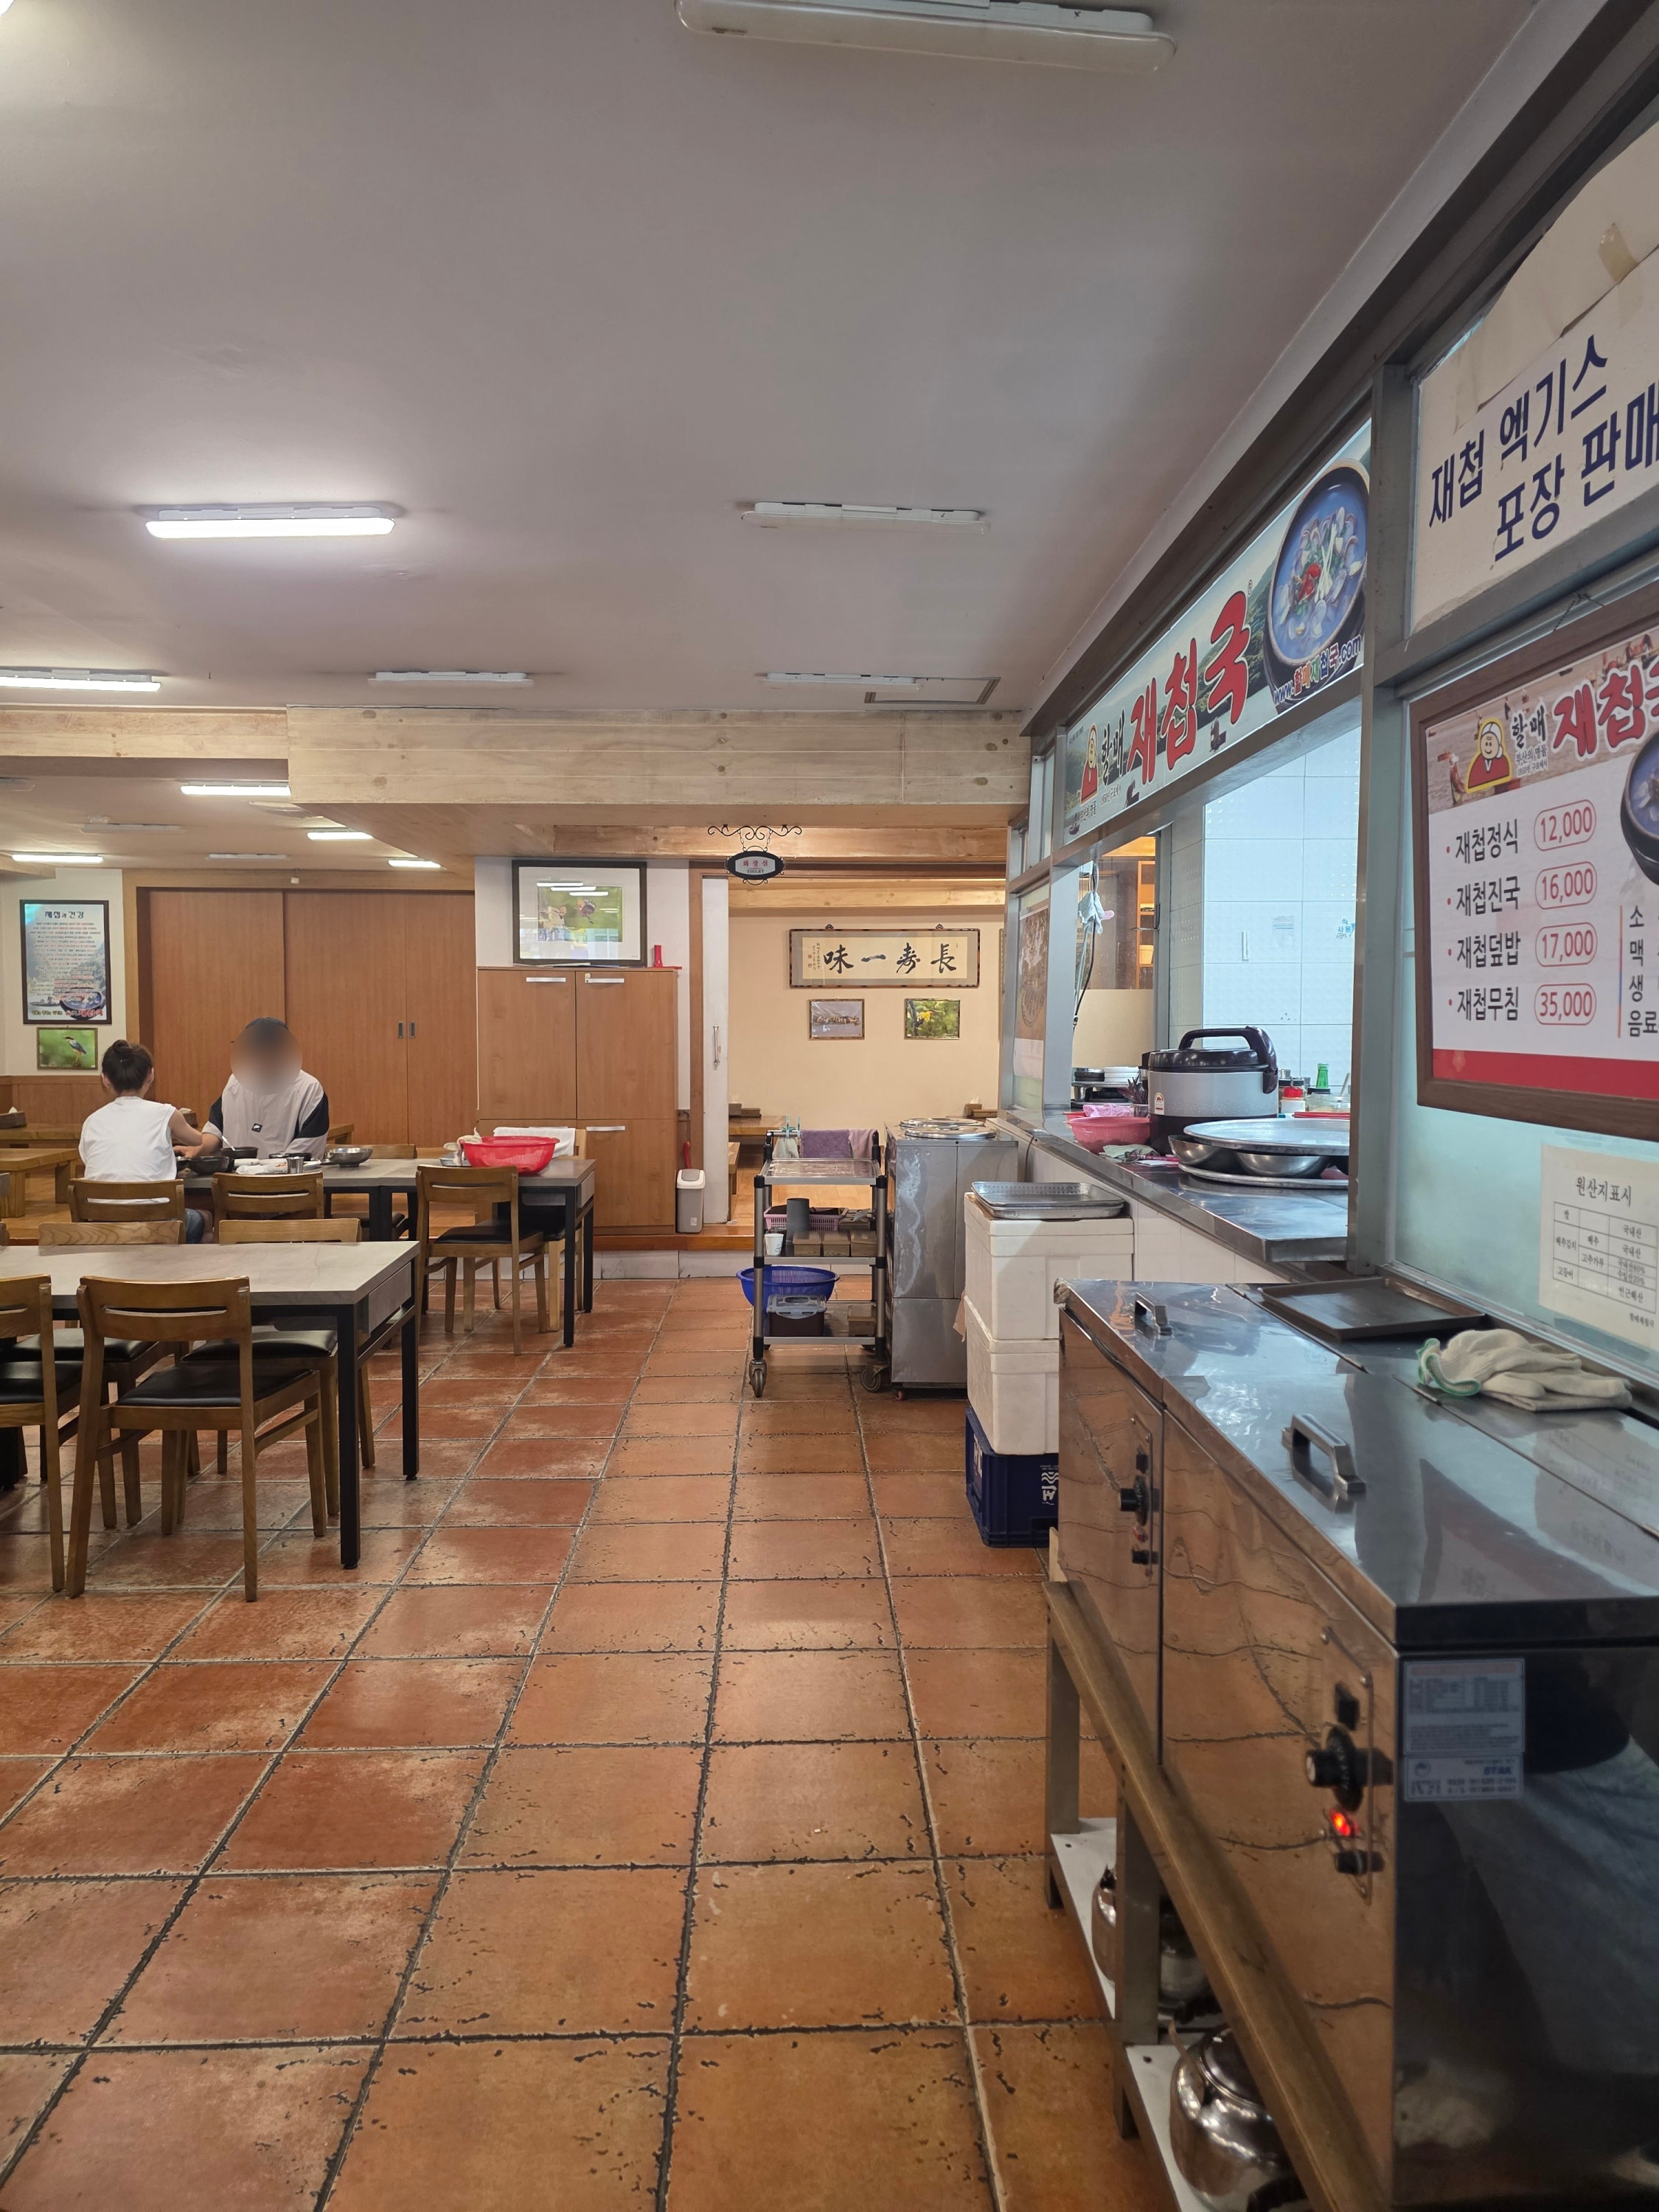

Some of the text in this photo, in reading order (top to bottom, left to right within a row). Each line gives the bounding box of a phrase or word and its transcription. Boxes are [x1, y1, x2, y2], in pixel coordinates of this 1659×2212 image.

[1429, 334, 1608, 529] 재첩 엑기스
[1495, 379, 1659, 562] 포장 판매
[1102, 591, 1250, 786] 할매 재첩국
[1512, 705, 1546, 748] 할매
[1516, 748, 1534, 765] 부산의
[1455, 807, 1593, 864] 재첩정식 12,000
[1456, 868, 1593, 917] 재첩진국 16,000
[1457, 929, 1594, 969] 재첩덮밥 17,000
[1457, 987, 1593, 1021] 재첩무침 35,000
[1628, 1010, 1659, 1037] 음료
[1576, 1176, 1632, 1208] 원산지표시
[1556, 1237, 1576, 1251] 배추김치
[1587, 1235, 1599, 1247] 배추
[1623, 1225, 1642, 1239] 국내산
[1622, 1245, 1641, 1259] 국내산
